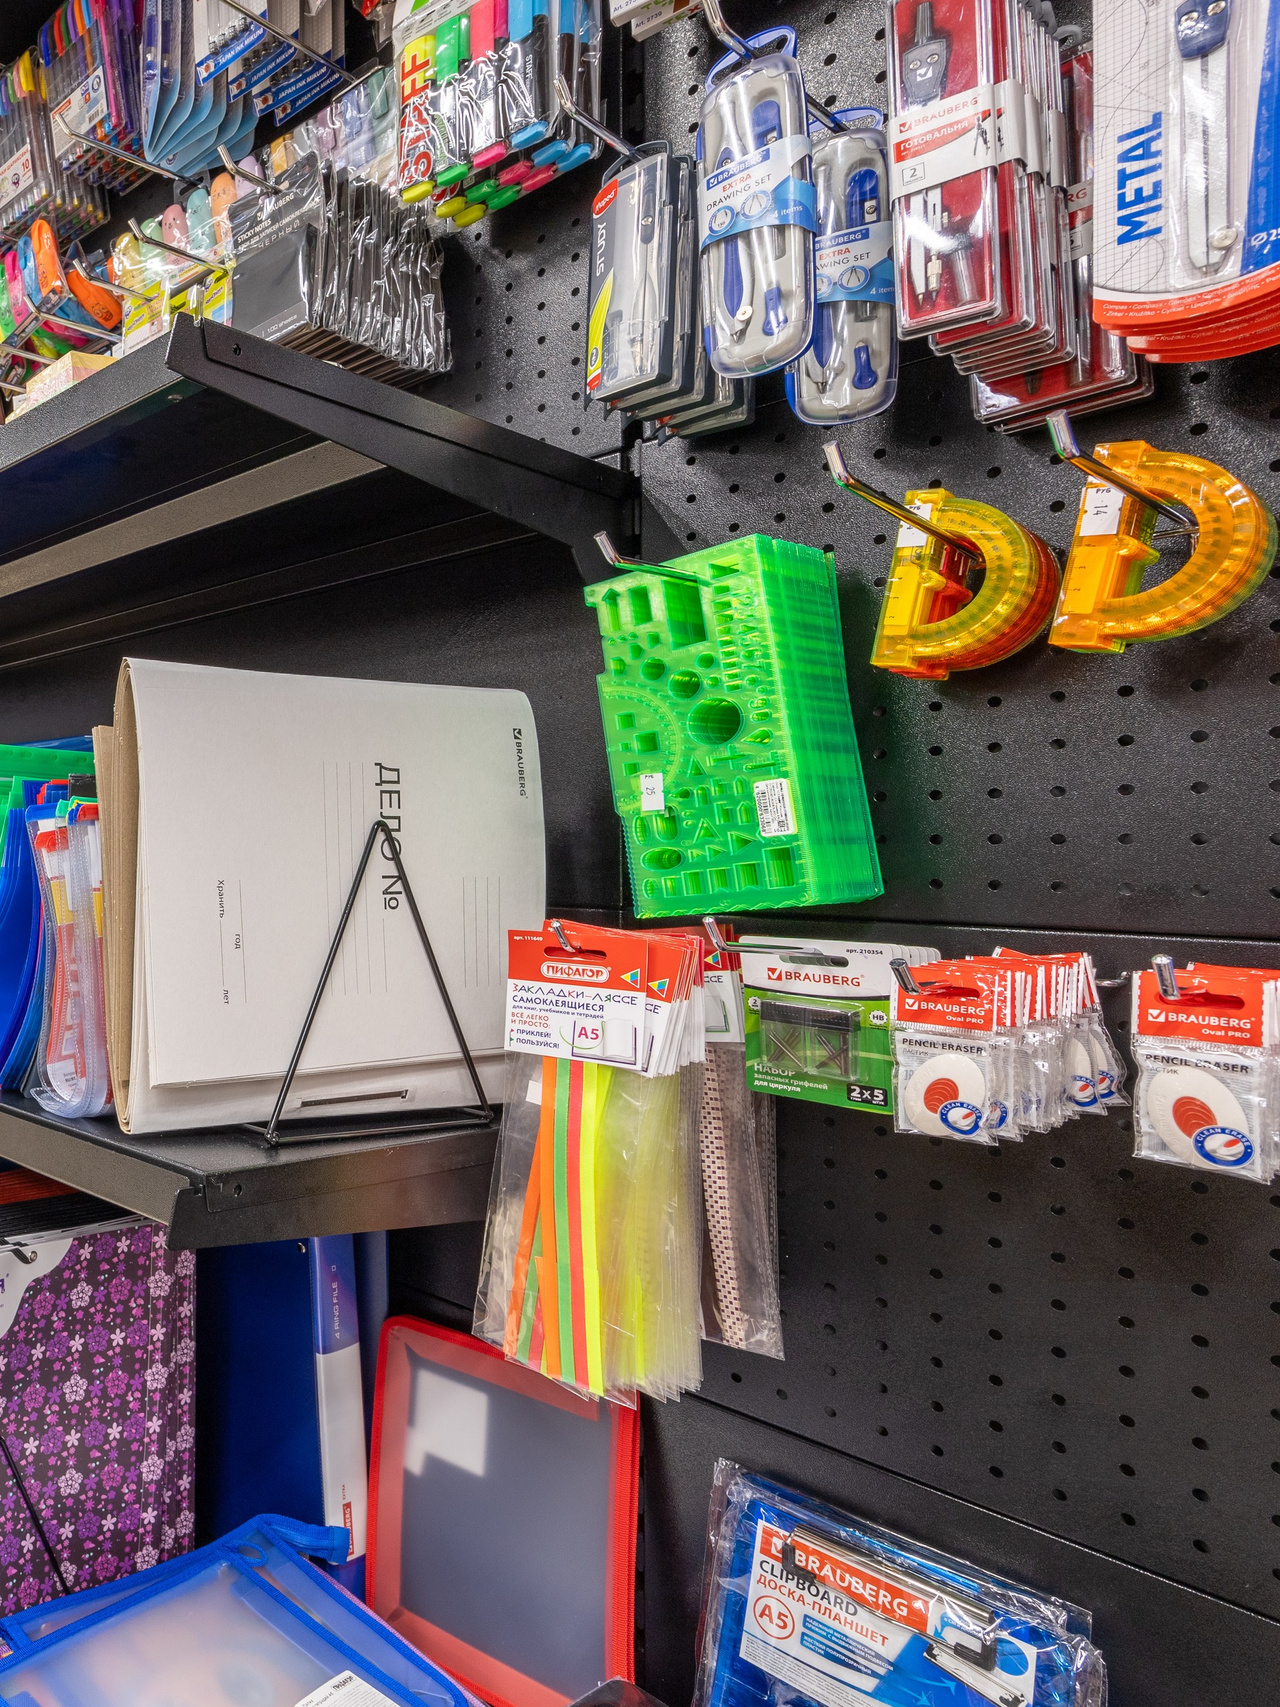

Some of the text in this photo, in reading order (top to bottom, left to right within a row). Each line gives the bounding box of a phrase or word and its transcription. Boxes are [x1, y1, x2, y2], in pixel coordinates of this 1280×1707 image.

[634, 11, 662, 28] Art. 2739
[218, 28, 264, 65] JAPAN INK MIKUNI
[250, 46, 295, 83] JAPAN INK MIKUNI
[524, 55, 533, 80] STAFF
[278, 66, 327, 99] JAPAN INK MIKUNI
[913, 97, 978, 127] BRAUBERG
[900, 121, 969, 150] ГОТОВАЛЬНЯ
[22, 158, 30, 171] 10
[717, 154, 763, 181] BRAUBERG
[910, 168, 918, 178] 2
[722, 173, 752, 192] EXTRA
[1117, 111, 1162, 245] METAL
[706, 173, 772, 211] DRAWING SET
[780, 205, 803, 216] items
[237, 218, 272, 243] STICKY NOTES
[258, 219, 300, 248] ЧЕРНЫЙ
[596, 221, 607, 277] STUDY
[819, 247, 851, 260] EXTRA
[816, 252, 871, 271] AWING SET
[878, 285, 895, 294] item
[1103, 303, 1128, 311] Compas
[514, 741, 528, 797] BRAUBERG
[375, 763, 402, 863] ДЕЛО
[217, 880, 225, 918] Хранить
[234, 934, 242, 949] год
[546, 964, 604, 979] ПИФАГОР
[785, 971, 860, 987] BRAUBERG
[512, 995, 604, 1012] САМОКЛЕЯЩИЕСЯ
[524, 1005, 538, 1013] книг,
[539, 1007, 570, 1016] учебников
[920, 1002, 985, 1016] BRAUBERG
[518, 1019, 551, 1029] ПРОСТО:
[526, 1013, 549, 1022] ЛЕГКО
[946, 1015, 984, 1024] Oval PRO
[1168, 1012, 1251, 1029] BRAUBERG
[516, 1029, 551, 1038] ПРИКЛЕЙ!
[1201, 1028, 1250, 1038] Oval PRO
[516, 1037, 560, 1049] ПОЛЬЗУЙСЯ!
[902, 1038, 983, 1054] PENCIL ERASER
[754, 1063, 796, 1077] НАБОР
[1145, 1054, 1249, 1073] PENCIL ERASER
[754, 1073, 828, 1090] запасных грифелей
[769, 1081, 801, 1092] циркуля
[942, 1102, 982, 1118] CLEAN ERASE
[1197, 1128, 1250, 1146] CLEAN ERASE
[331, 1281, 339, 1305] FILE
[334, 1331, 341, 1339] 4
[759, 1559, 859, 1617] CLIPBOARD
[794, 1550, 909, 1616] BRAUBERG
[756, 1573, 889, 1647] ДОСКА-ПЛАНШЕТ
[805, 1617, 834, 1634] НАДЕЖНЫЙ
[802, 1640, 825, 1655] ПЛАСТИК
[803, 1635, 872, 1675] ЖЕСТКИЙ ПОЛУПРОЗРАЧНЫЙ
[805, 1622, 827, 1638] ПРИЖИМ
[832, 1636, 865, 1657] ВЫДВИЖНЫМ
[865, 1654, 894, 1671] ПОДВЕСОМ
